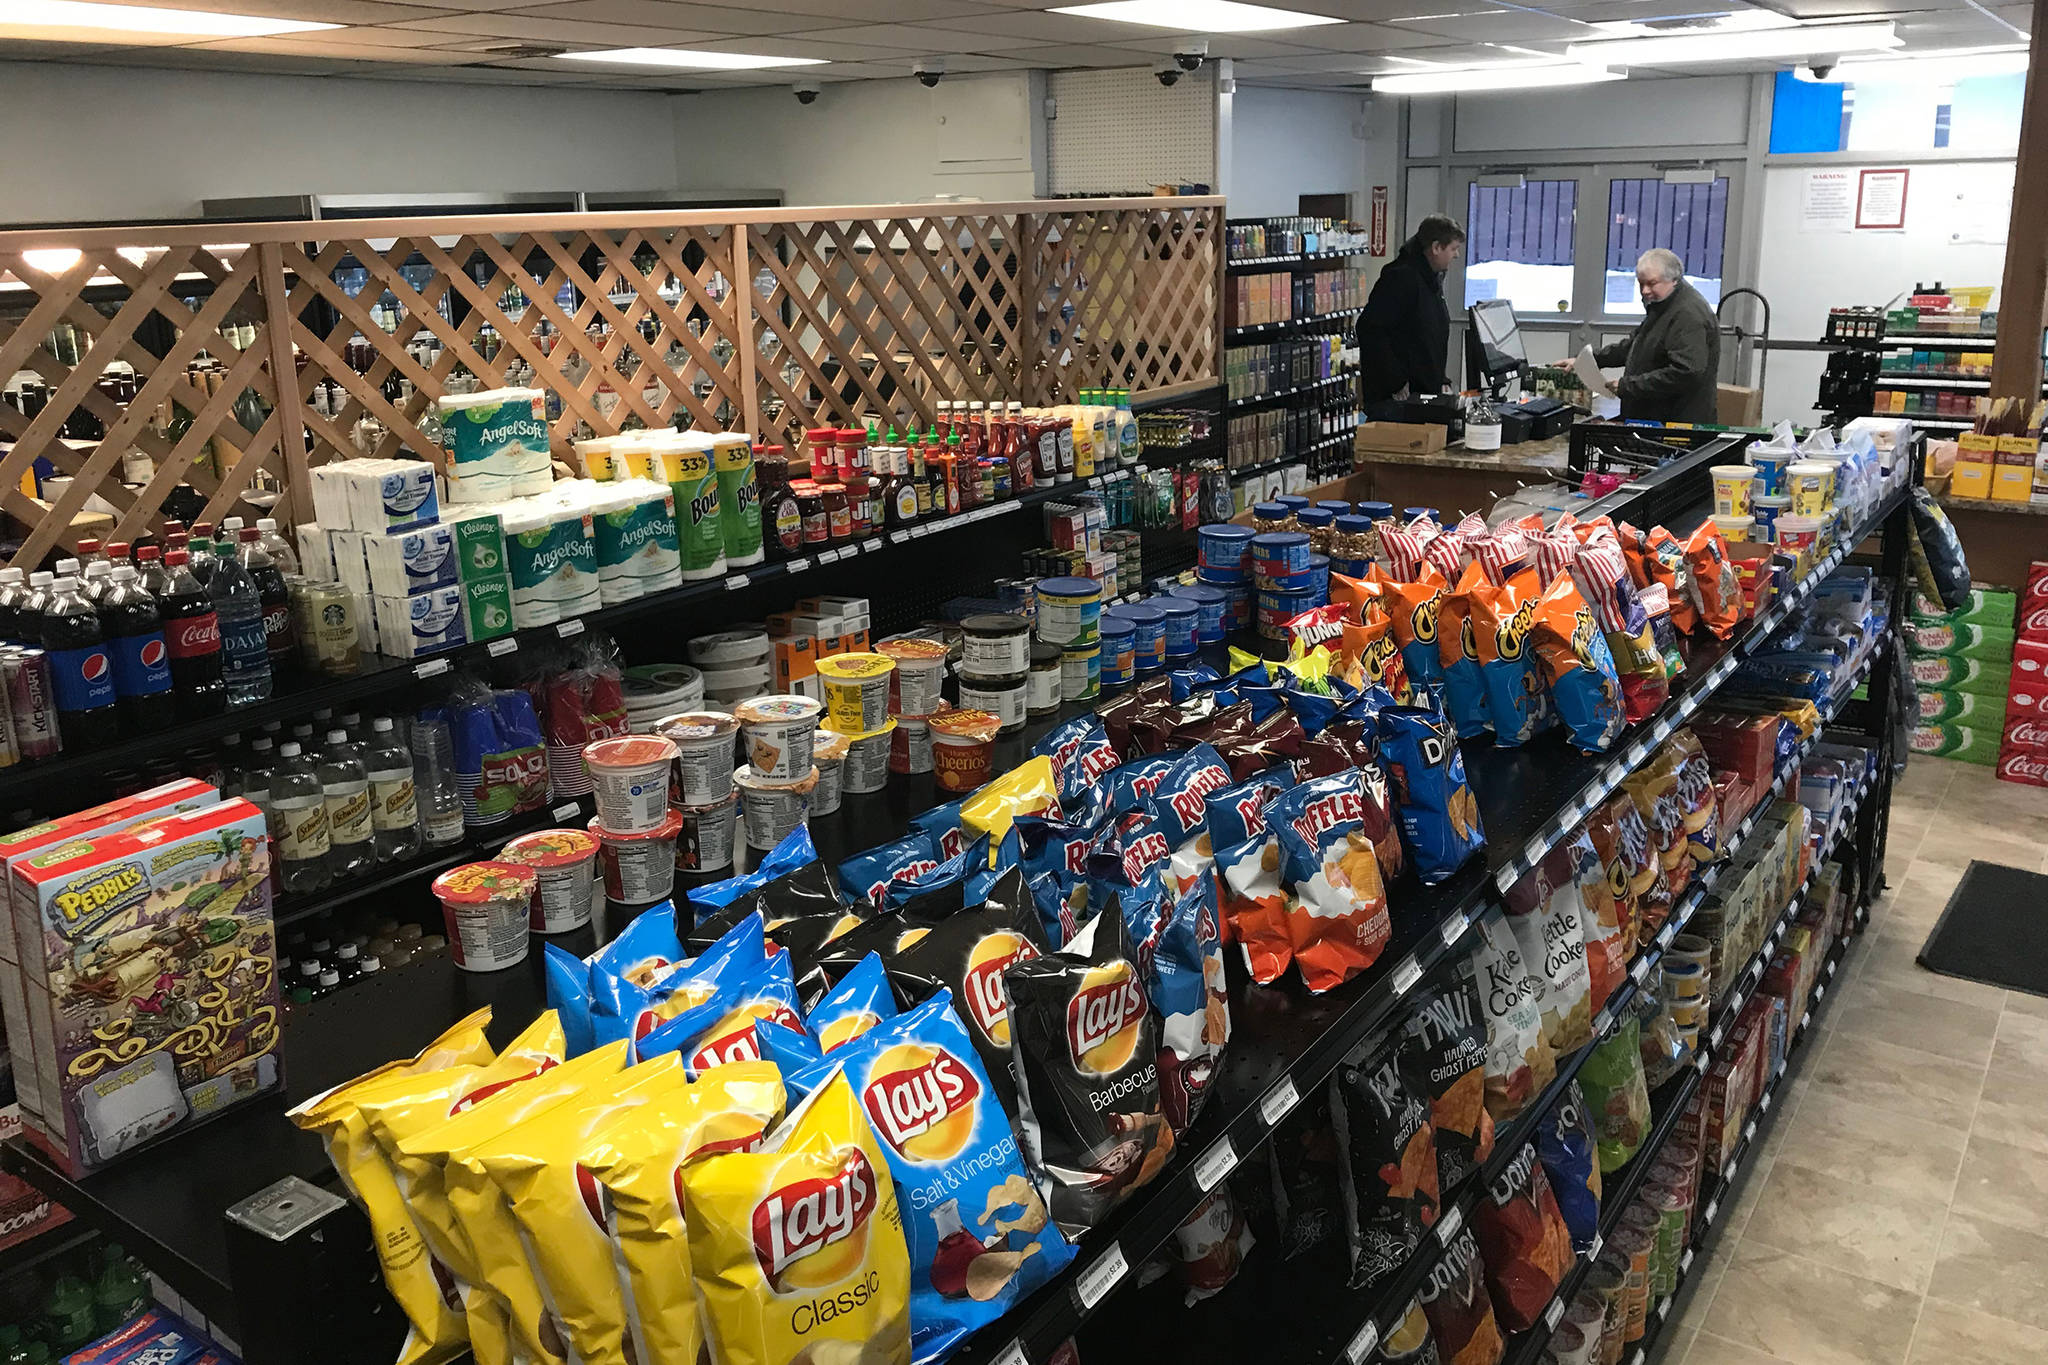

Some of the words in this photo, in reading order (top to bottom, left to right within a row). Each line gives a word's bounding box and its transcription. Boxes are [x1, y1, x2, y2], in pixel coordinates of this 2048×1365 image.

[443, 427, 457, 437] ngel
[479, 423, 520, 445] Angel
[518, 420, 543, 439] Soft
[680, 456, 707, 472] 33%
[461, 523, 497, 538] Kleenex
[619, 527, 655, 549] Angel
[653, 519, 676, 538] Soft
[531, 549, 573, 572] Angel
[571, 540, 594, 559] Soft
[471, 583, 505, 599] Kleenex
[486, 755, 543, 784] SOLO
[936, 751, 985, 771] Cheerios
[55, 866, 143, 923] PEBBLES
[1077, 977, 1141, 1056] Lay's
[1444, 1036, 1478, 1063] HAUNTED
[1430, 1059, 1464, 1083] GHOST
[872, 1057, 964, 1147] Lay's
[1089, 1063, 1157, 1112] Barbecue
[911, 1180, 948, 1211] Salt
[947, 1169, 962, 1190] &
[960, 1133, 1015, 1182] Vinegar
[765, 1150, 868, 1276] Lay's
[791, 1269, 881, 1337] Classic
